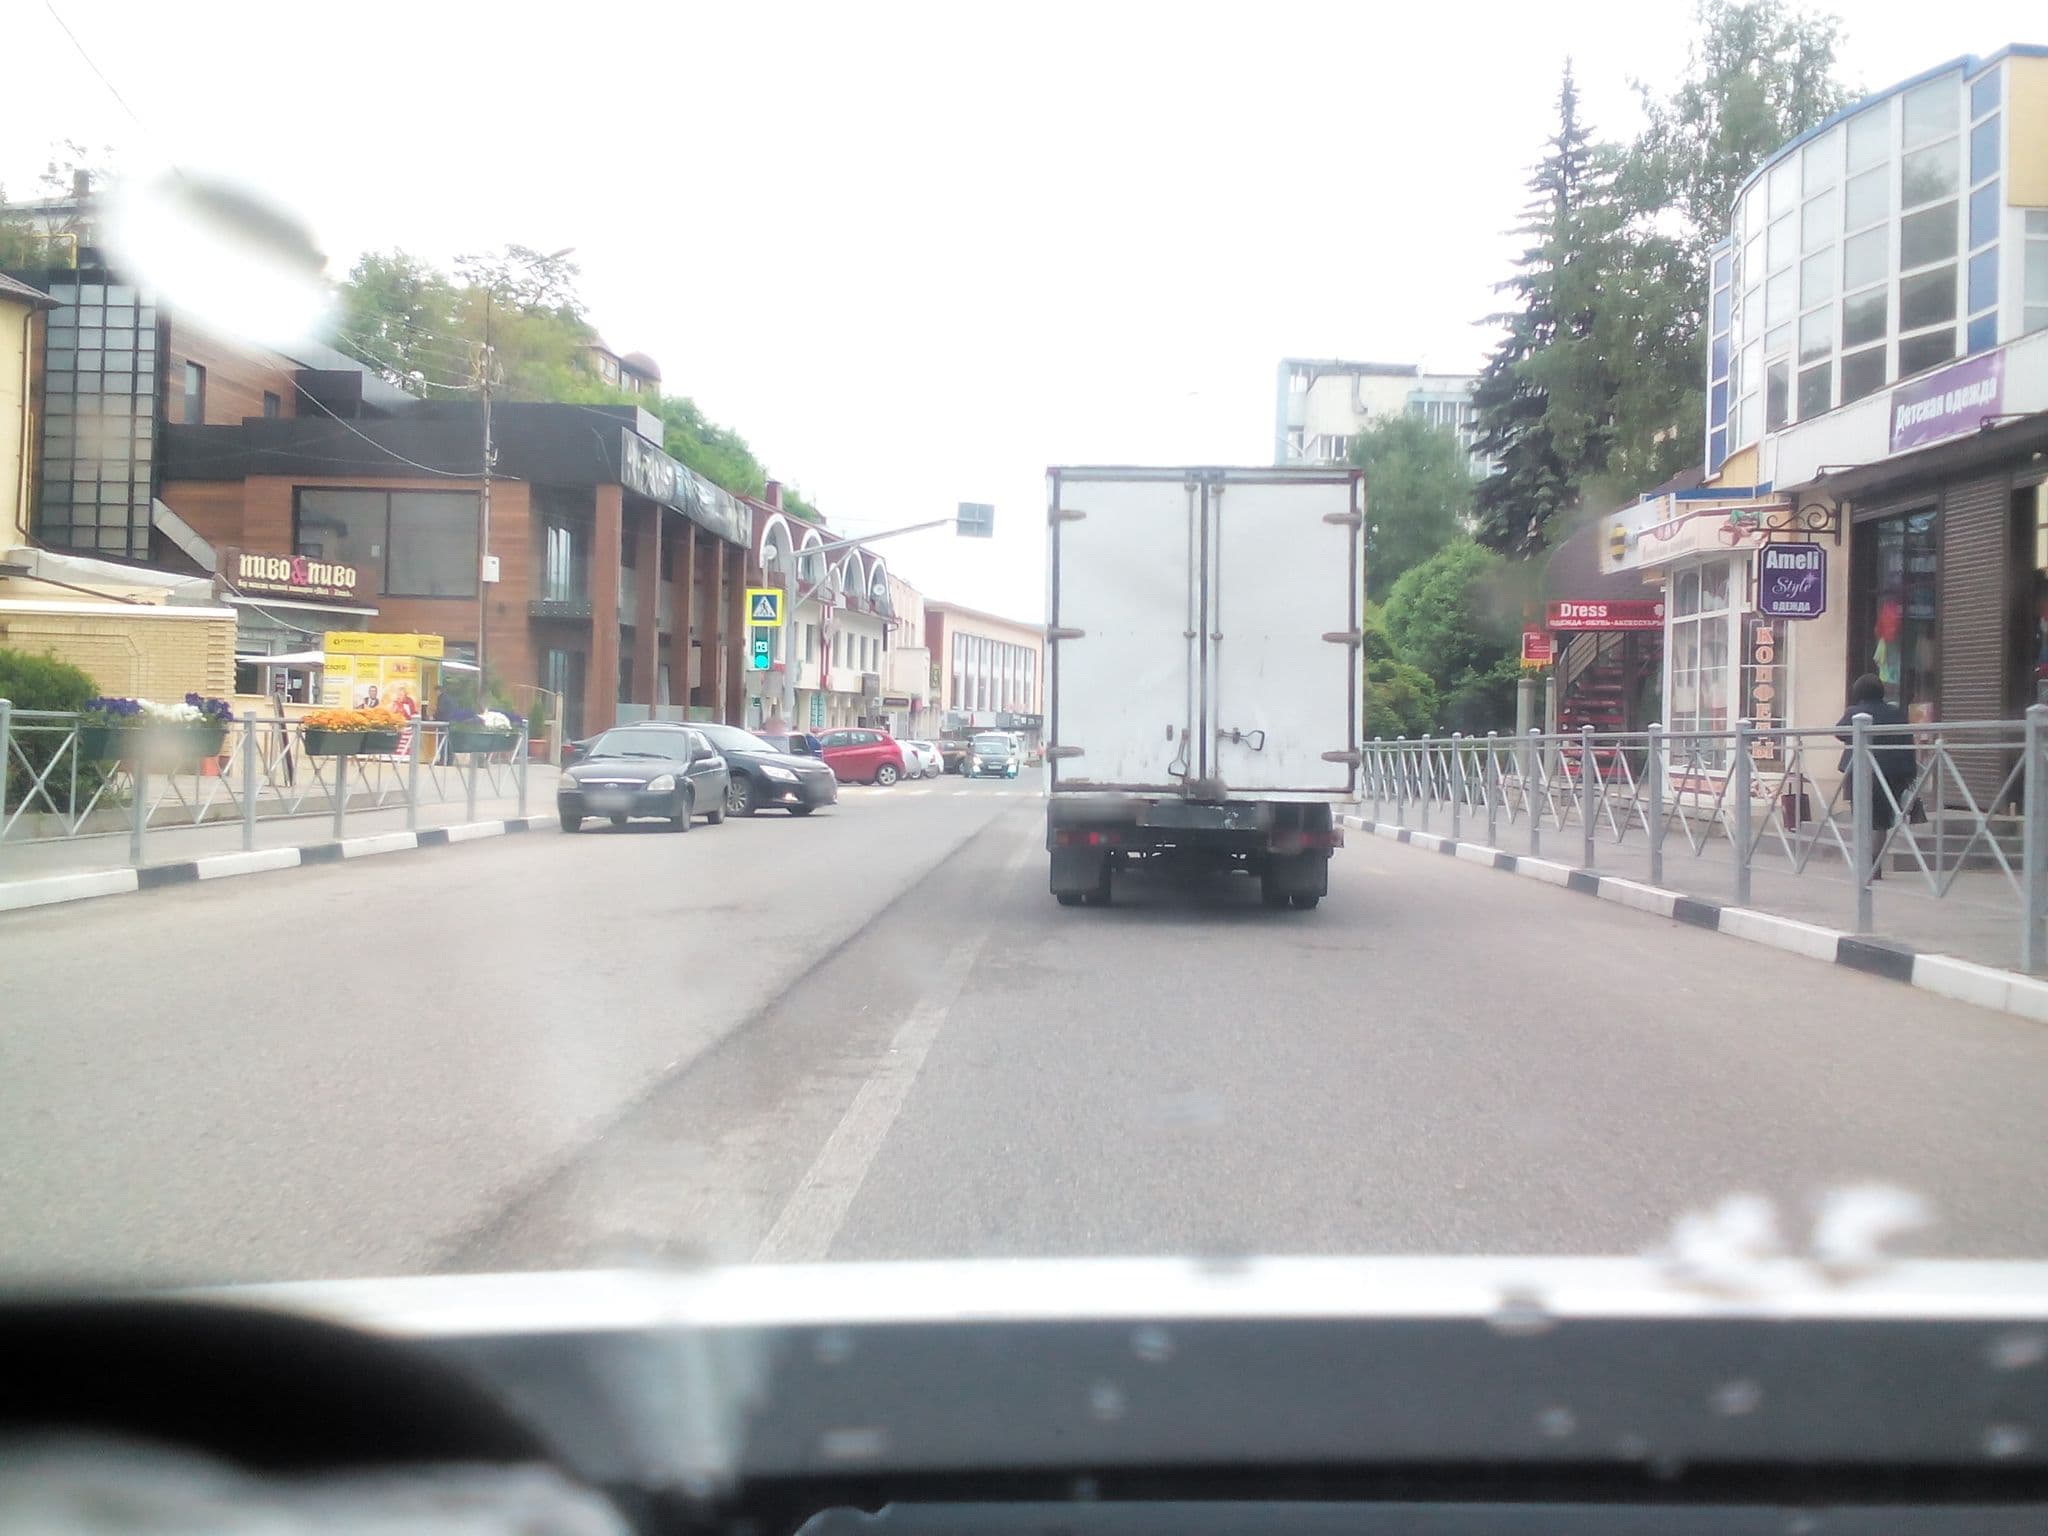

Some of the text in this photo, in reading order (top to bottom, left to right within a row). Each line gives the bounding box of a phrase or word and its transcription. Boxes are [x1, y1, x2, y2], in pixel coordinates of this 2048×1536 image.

[1895, 395, 1944, 437] Детская
[1766, 550, 1819, 570] Ameli
[1772, 576, 1813, 599] Style
[1560, 603, 1608, 617] Dress
[1772, 601, 1811, 612] ОДЕЖДА
